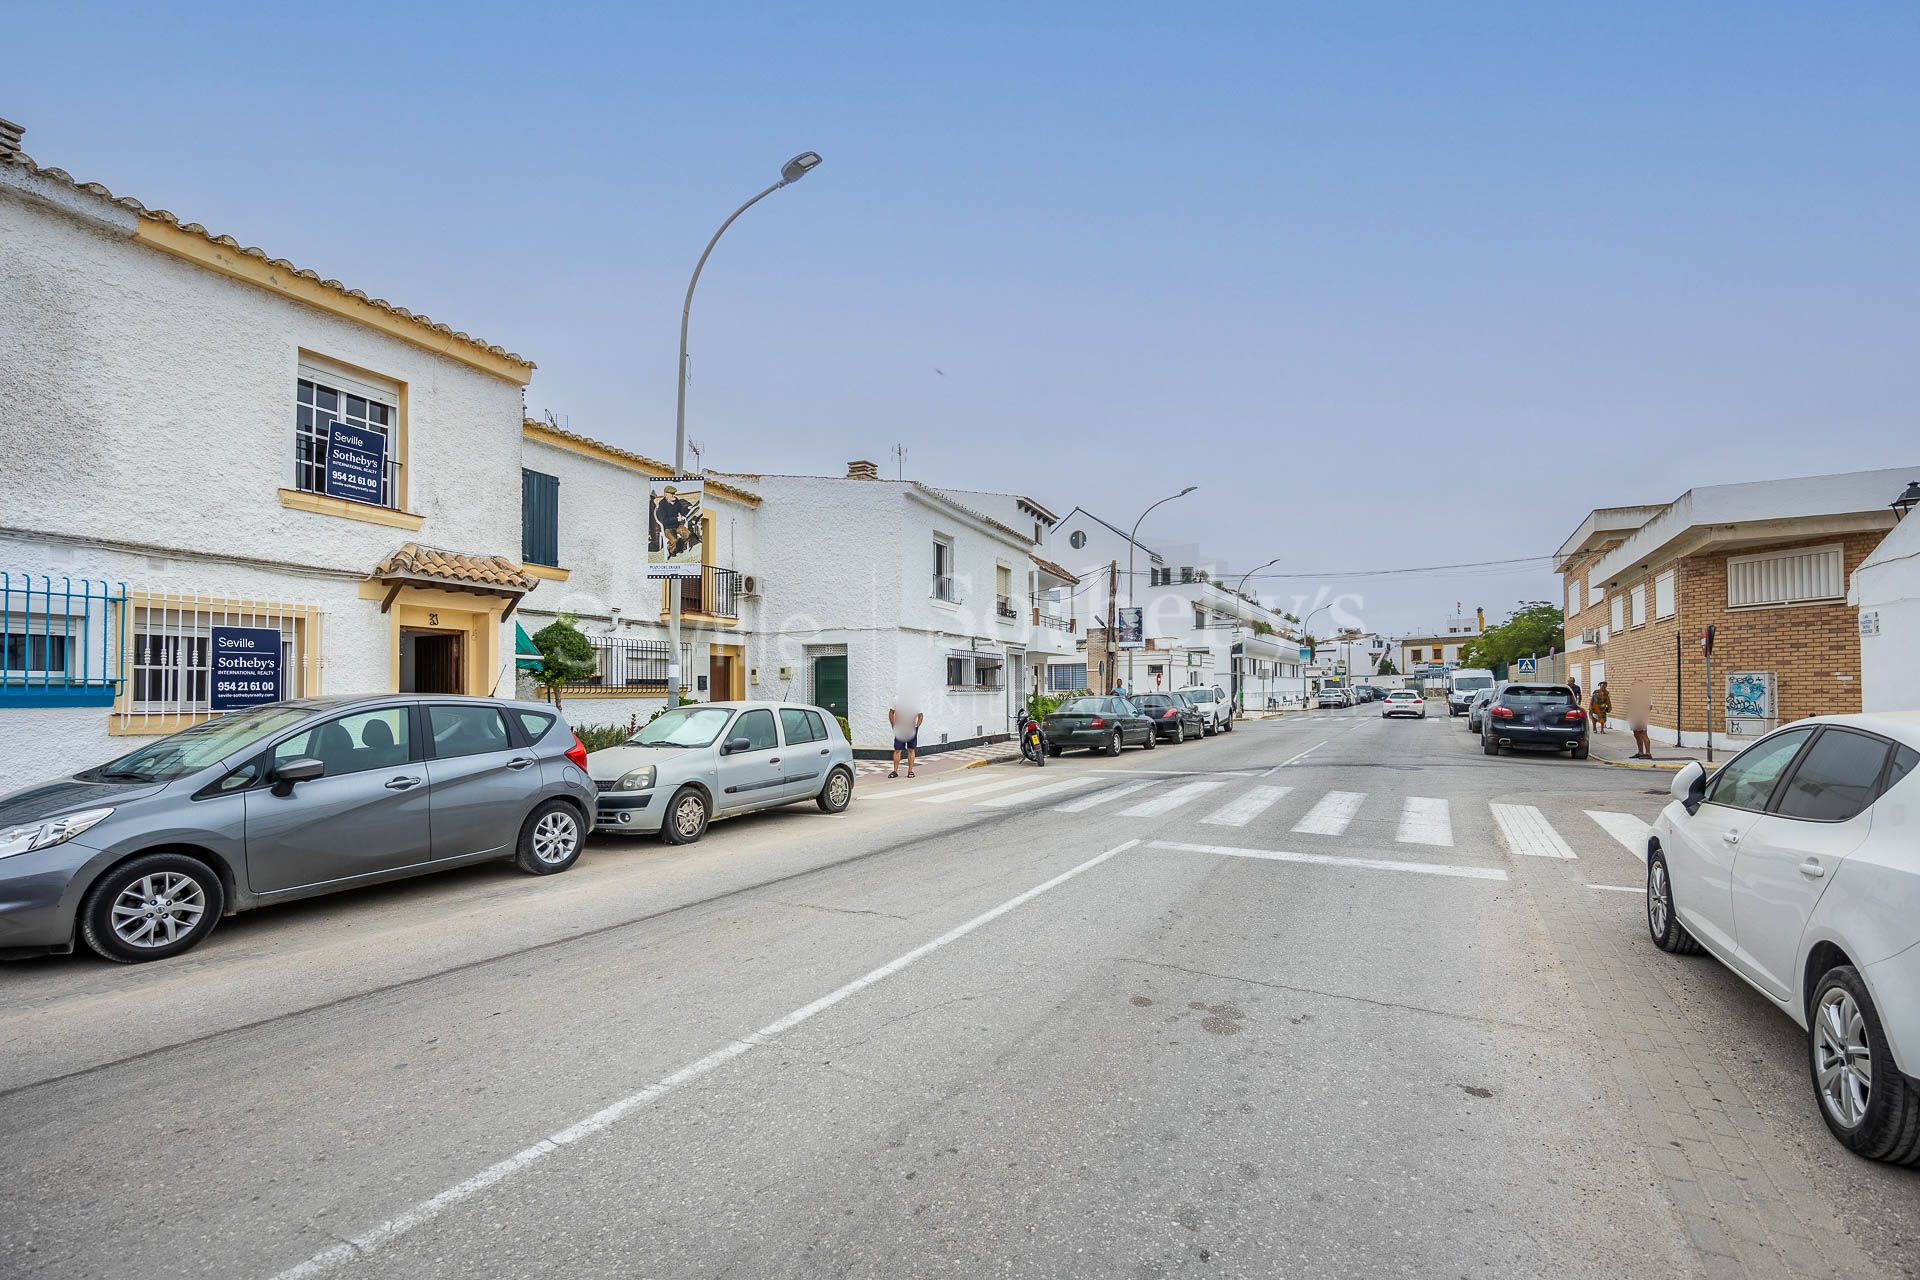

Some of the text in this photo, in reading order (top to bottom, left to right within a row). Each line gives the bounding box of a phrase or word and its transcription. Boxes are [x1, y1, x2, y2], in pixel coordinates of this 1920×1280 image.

[334, 431, 364, 447] Seville
[332, 449, 378, 468] Sotheby's
[332, 470, 377, 488] 954 21 61 00
[218, 636, 255, 648] Seville
[218, 656, 275, 670] Sotheby's
[218, 682, 274, 691] 954 21 61 00
